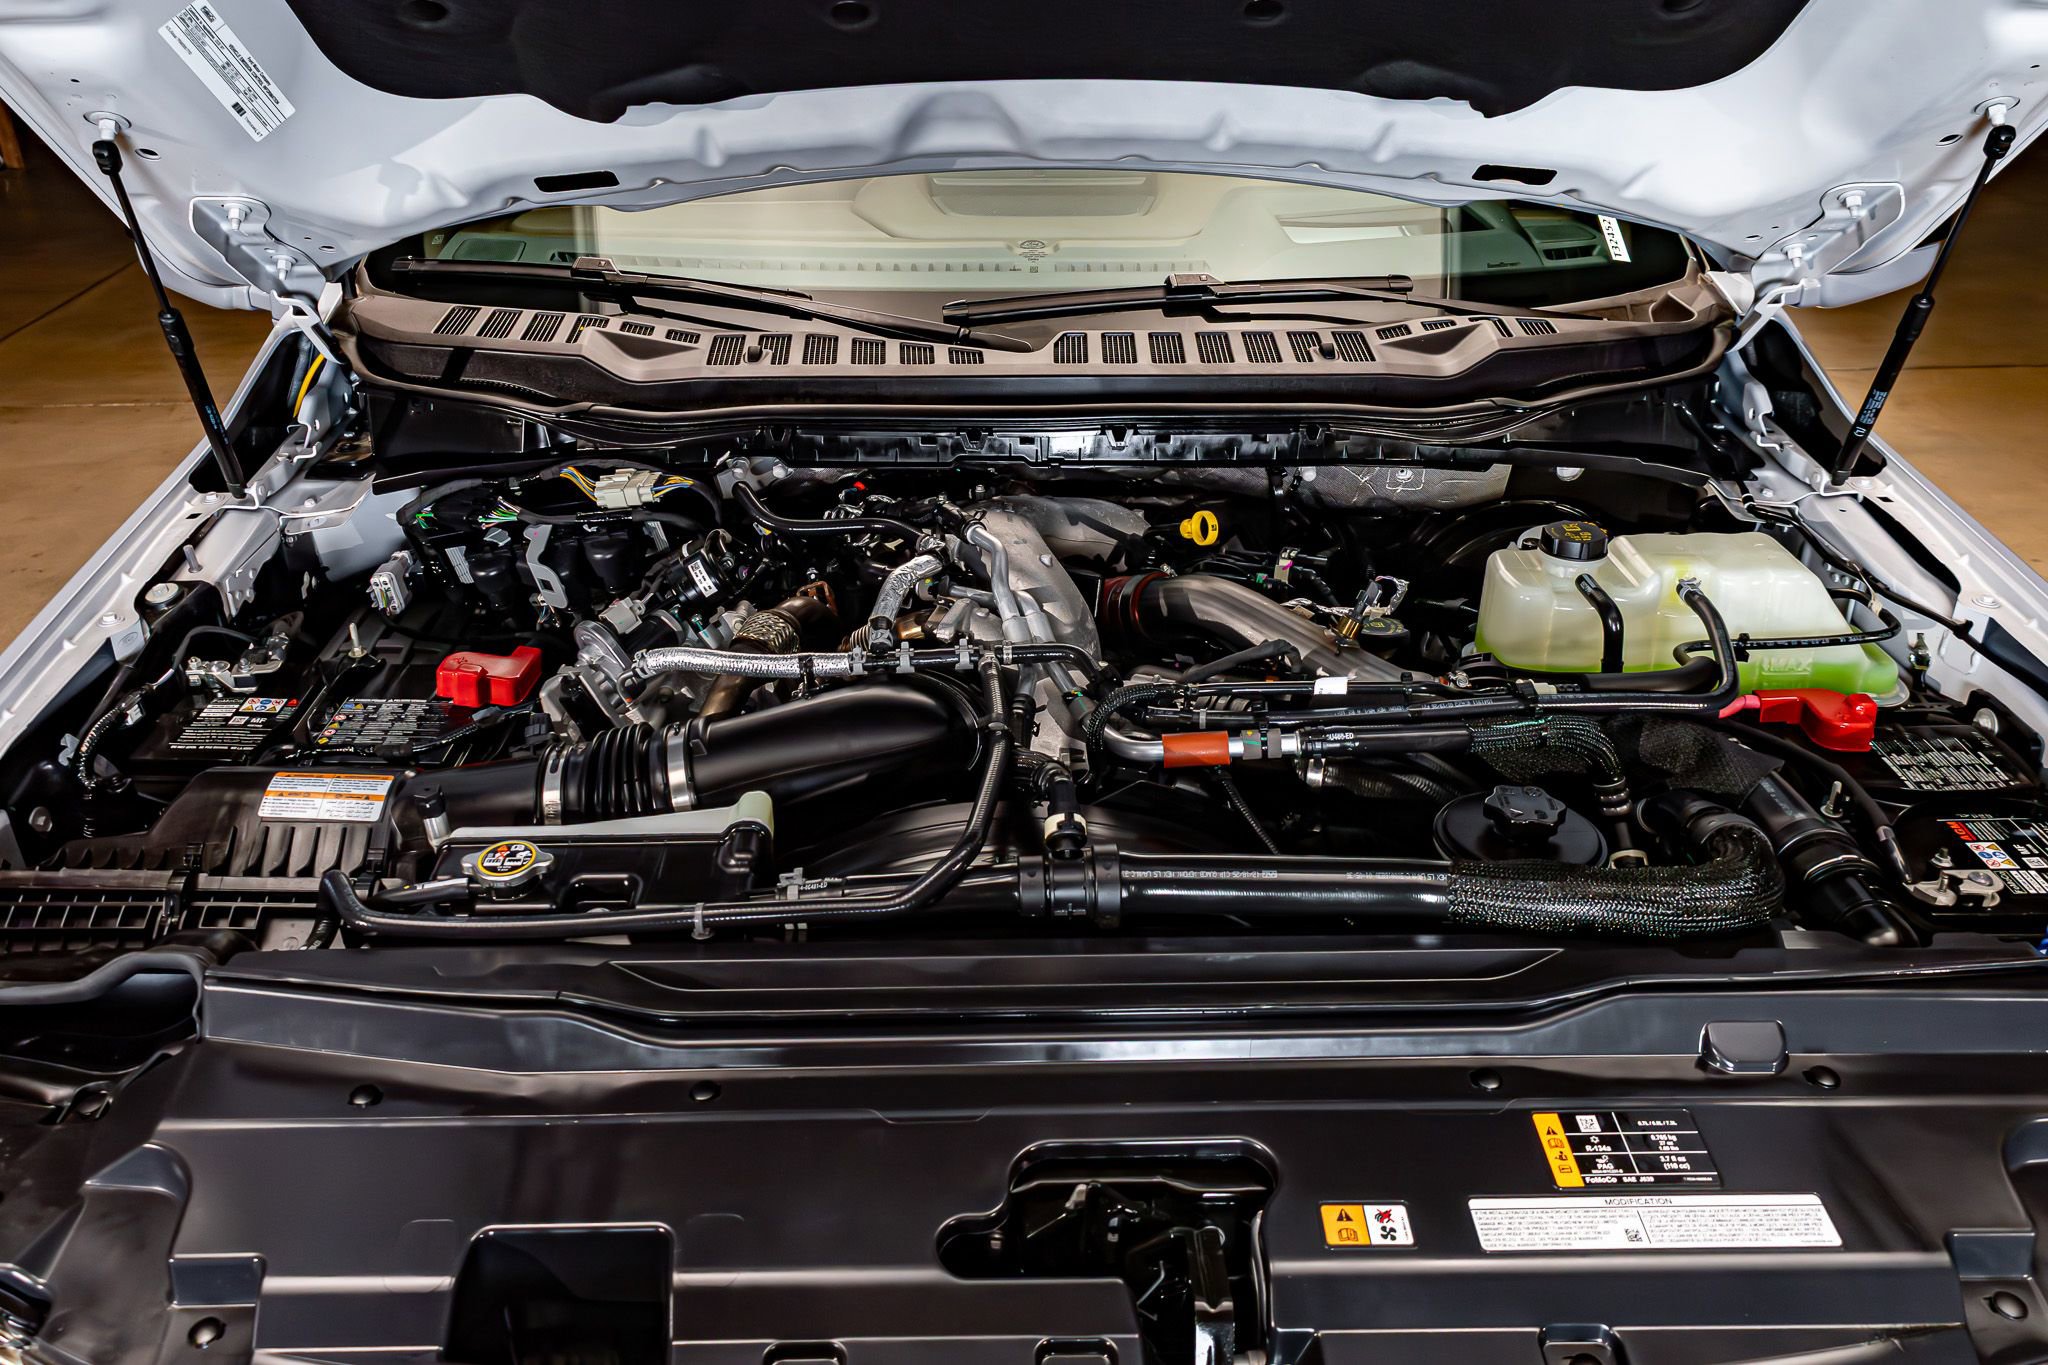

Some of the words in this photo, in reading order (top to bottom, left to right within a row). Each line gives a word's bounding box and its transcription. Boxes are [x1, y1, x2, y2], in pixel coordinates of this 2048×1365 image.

[1602, 218, 1623, 258] T32452
[1585, 1176, 1618, 1184] FoMoCo
[1604, 1197, 1673, 1206] MODIFICATION
